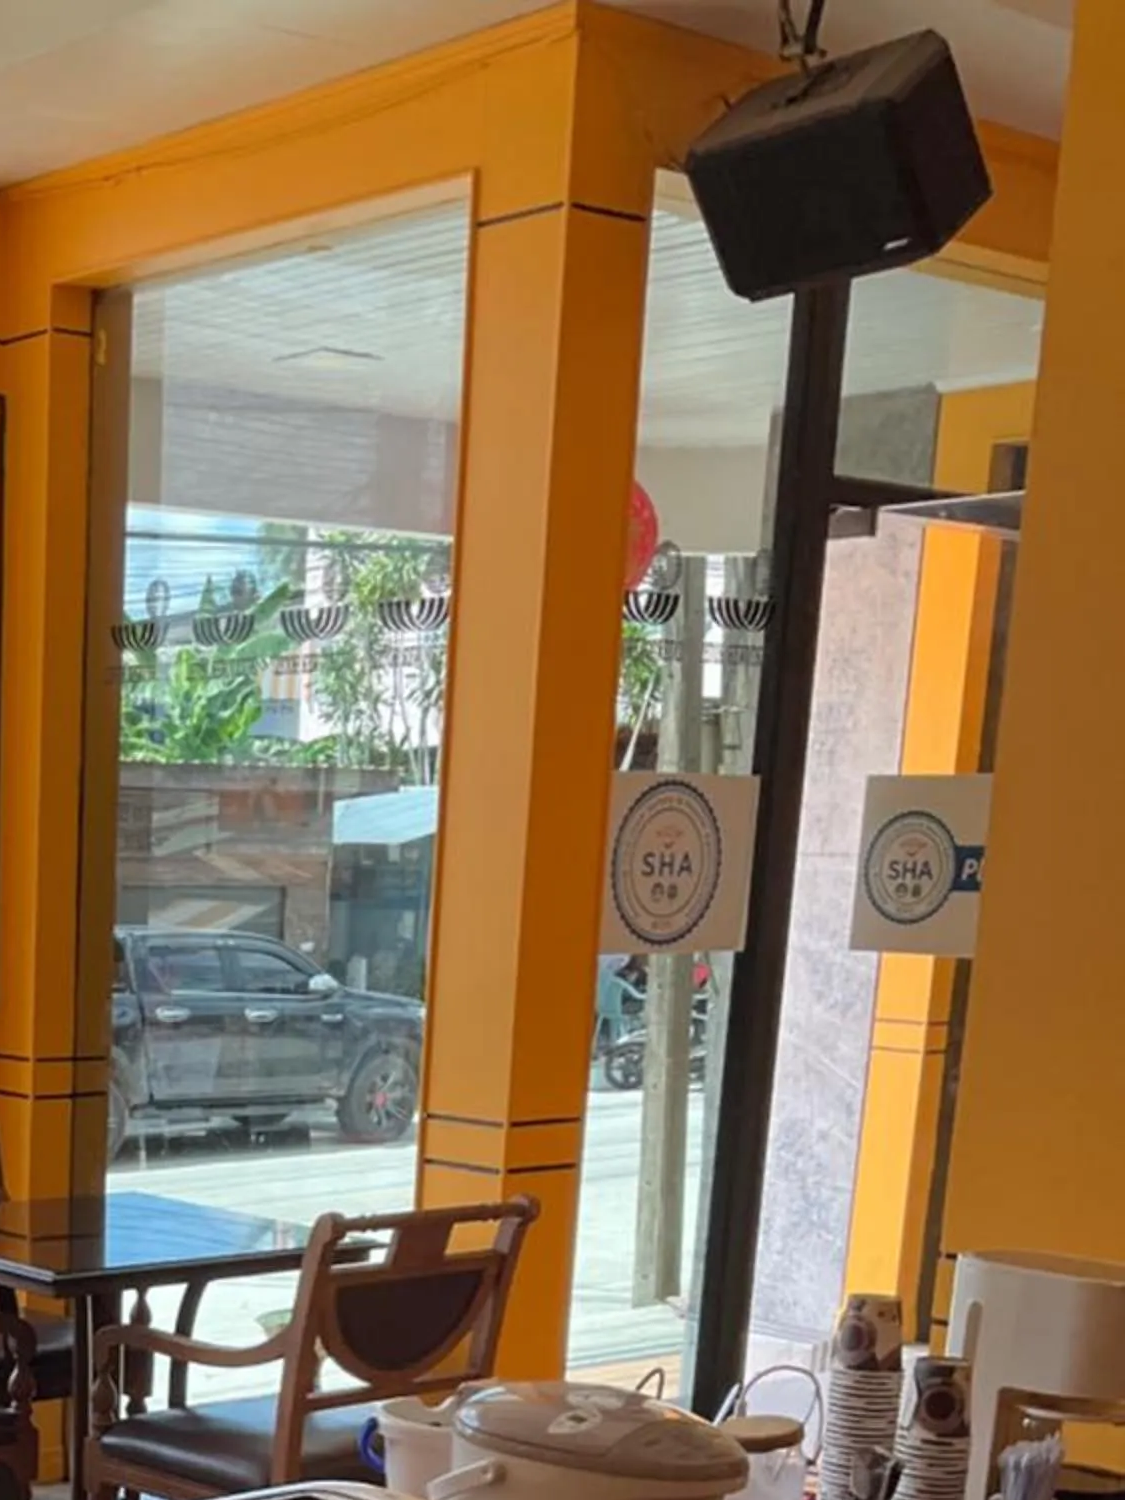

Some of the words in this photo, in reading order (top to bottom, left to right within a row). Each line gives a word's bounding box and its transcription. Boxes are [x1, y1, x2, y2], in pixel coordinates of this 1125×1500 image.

[641, 851, 693, 878] SHA
[887, 860, 933, 881] SHA
[961, 857, 985, 881] P
